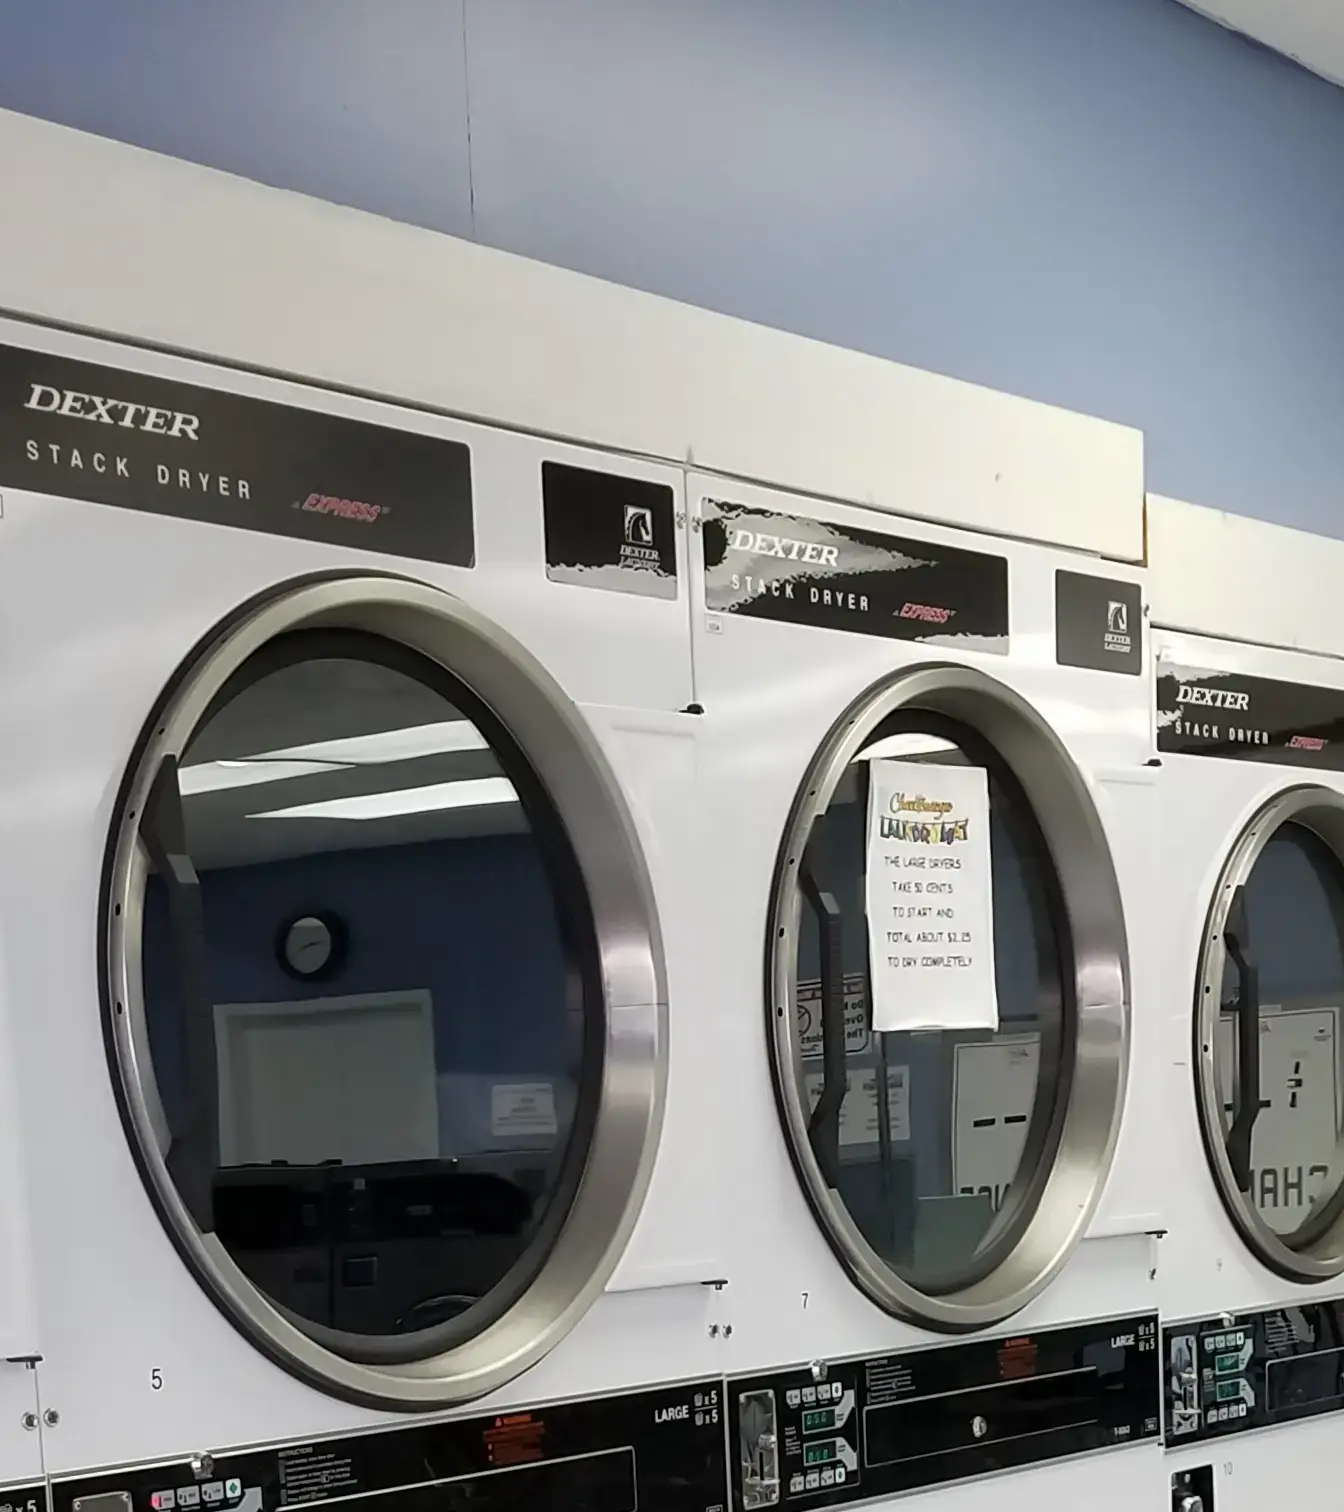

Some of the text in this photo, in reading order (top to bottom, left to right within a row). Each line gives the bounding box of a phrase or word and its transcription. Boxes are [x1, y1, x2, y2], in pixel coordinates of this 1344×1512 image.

[23, 383, 200, 440] DEXTER
[26, 440, 251, 500] STACK DRYER
[302, 492, 381, 523] EXPRESS
[619, 544, 659, 561] DEXTER
[733, 530, 839, 567] DEXTER
[730, 574, 869, 611] STACK DRYER
[899, 602, 951, 624] EXPRESS
[1175, 684, 1250, 710] DEXTER
[1174, 720, 1269, 745] STACK DRYER
[884, 856, 900, 867] THE
[892, 881, 912, 893] TAKE
[926, 882, 953, 894] CENTS
[892, 906, 954, 918] TO START AND
[887, 932, 912, 943] TOTAL
[916, 932, 943, 943] ABOUT
[887, 956, 899, 967] TO
[921, 956, 972, 967] COMPLETELY
[801, 1292, 808, 1309] 7
[1111, 1334, 1135, 1348] LARGE
[151, 1368, 162, 1389] 5
[711, 1390, 718, 1404] 5
[655, 1405, 689, 1423] LARGE
[712, 1409, 718, 1423] 5
